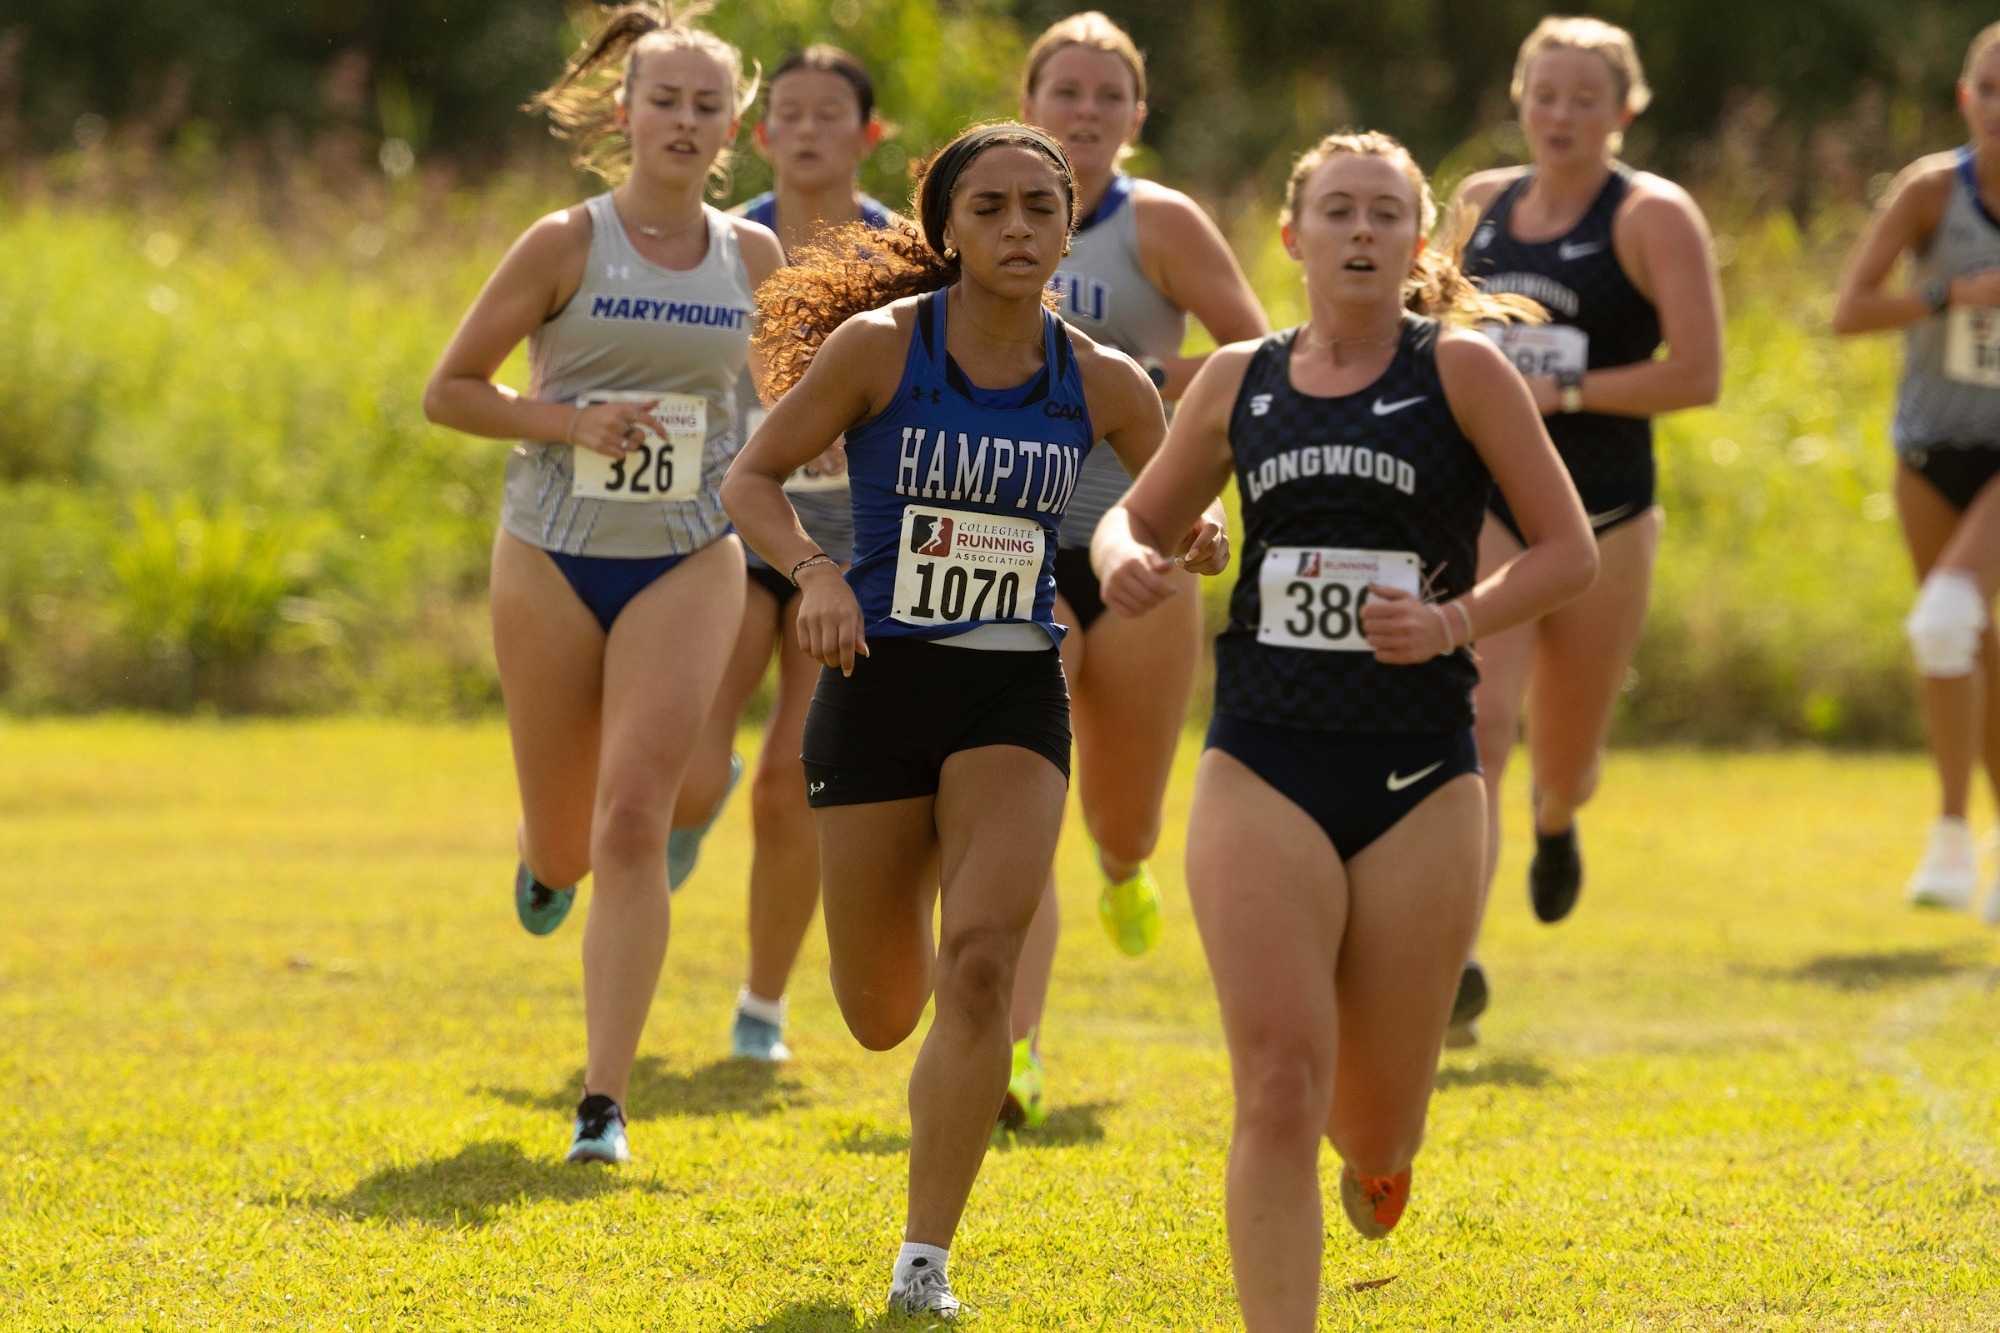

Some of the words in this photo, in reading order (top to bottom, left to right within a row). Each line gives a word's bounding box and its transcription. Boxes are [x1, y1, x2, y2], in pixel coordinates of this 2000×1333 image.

[590, 295, 747, 331] MARYMOUNT
[1048, 272, 1108, 324] U
[1043, 400, 1084, 422] CAA
[605, 443, 674, 493] 326
[895, 426, 1079, 515] HAMPTON
[1247, 444, 1416, 503] LONGWOOD
[956, 533, 1035, 553] RUNNING
[959, 522, 1034, 539] COLLEGIATE
[955, 552, 1034, 567] ASSOCIATION
[910, 562, 1020, 621] 1070
